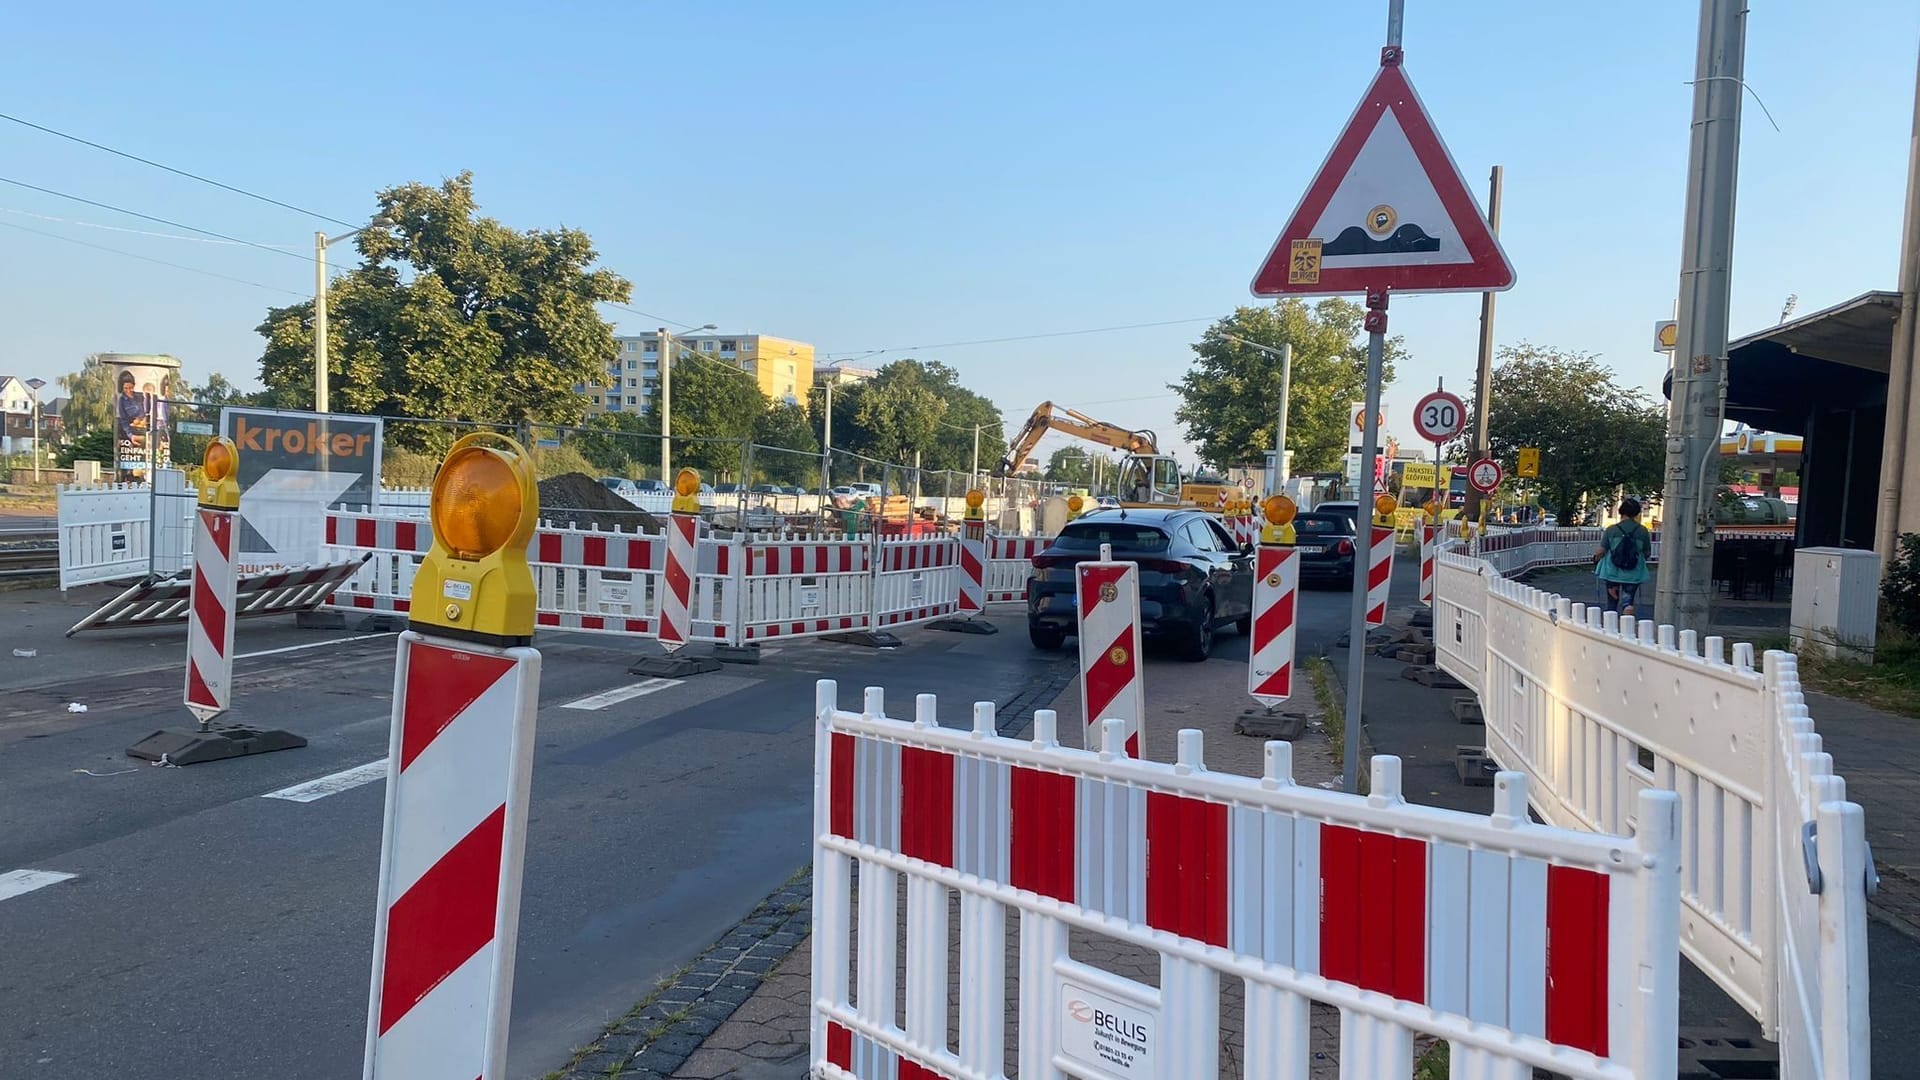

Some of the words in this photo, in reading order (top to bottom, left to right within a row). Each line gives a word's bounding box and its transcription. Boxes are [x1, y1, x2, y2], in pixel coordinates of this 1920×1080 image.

[1425, 406, 1454, 428] 30
[236, 417, 371, 457] kroker
[120, 454, 142, 462] GEHT
[1405, 473, 1434, 482] GEÖFFNET
[1094, 1009, 1147, 1043] BELLIS
[1094, 1027, 1114, 1041] Zukunft
[1114, 1035, 1120, 1043] in
[1120, 1038, 1147, 1055] Bewegung
